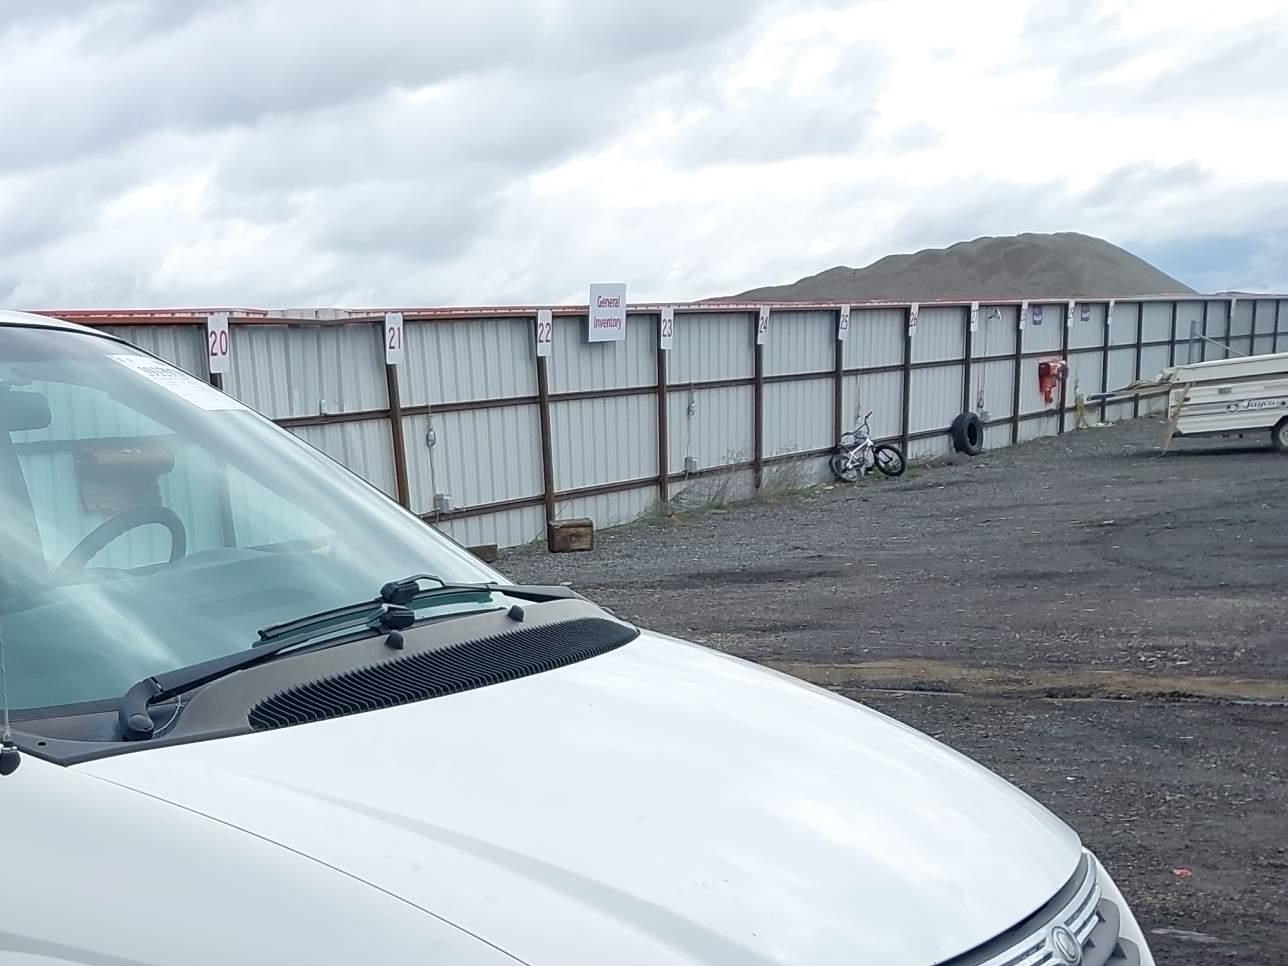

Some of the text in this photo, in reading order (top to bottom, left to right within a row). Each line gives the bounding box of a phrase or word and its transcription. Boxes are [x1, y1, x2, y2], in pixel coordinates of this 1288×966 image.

[597, 295, 620, 308] General
[593, 316, 622, 330] Inventory
[662, 318, 672, 337] 23
[759, 316, 768, 334] 24
[388, 326, 401, 350] 21
[538, 322, 551, 343] 22
[210, 330, 228, 357] 20
[1242, 400, 1276, 409] Jayco
